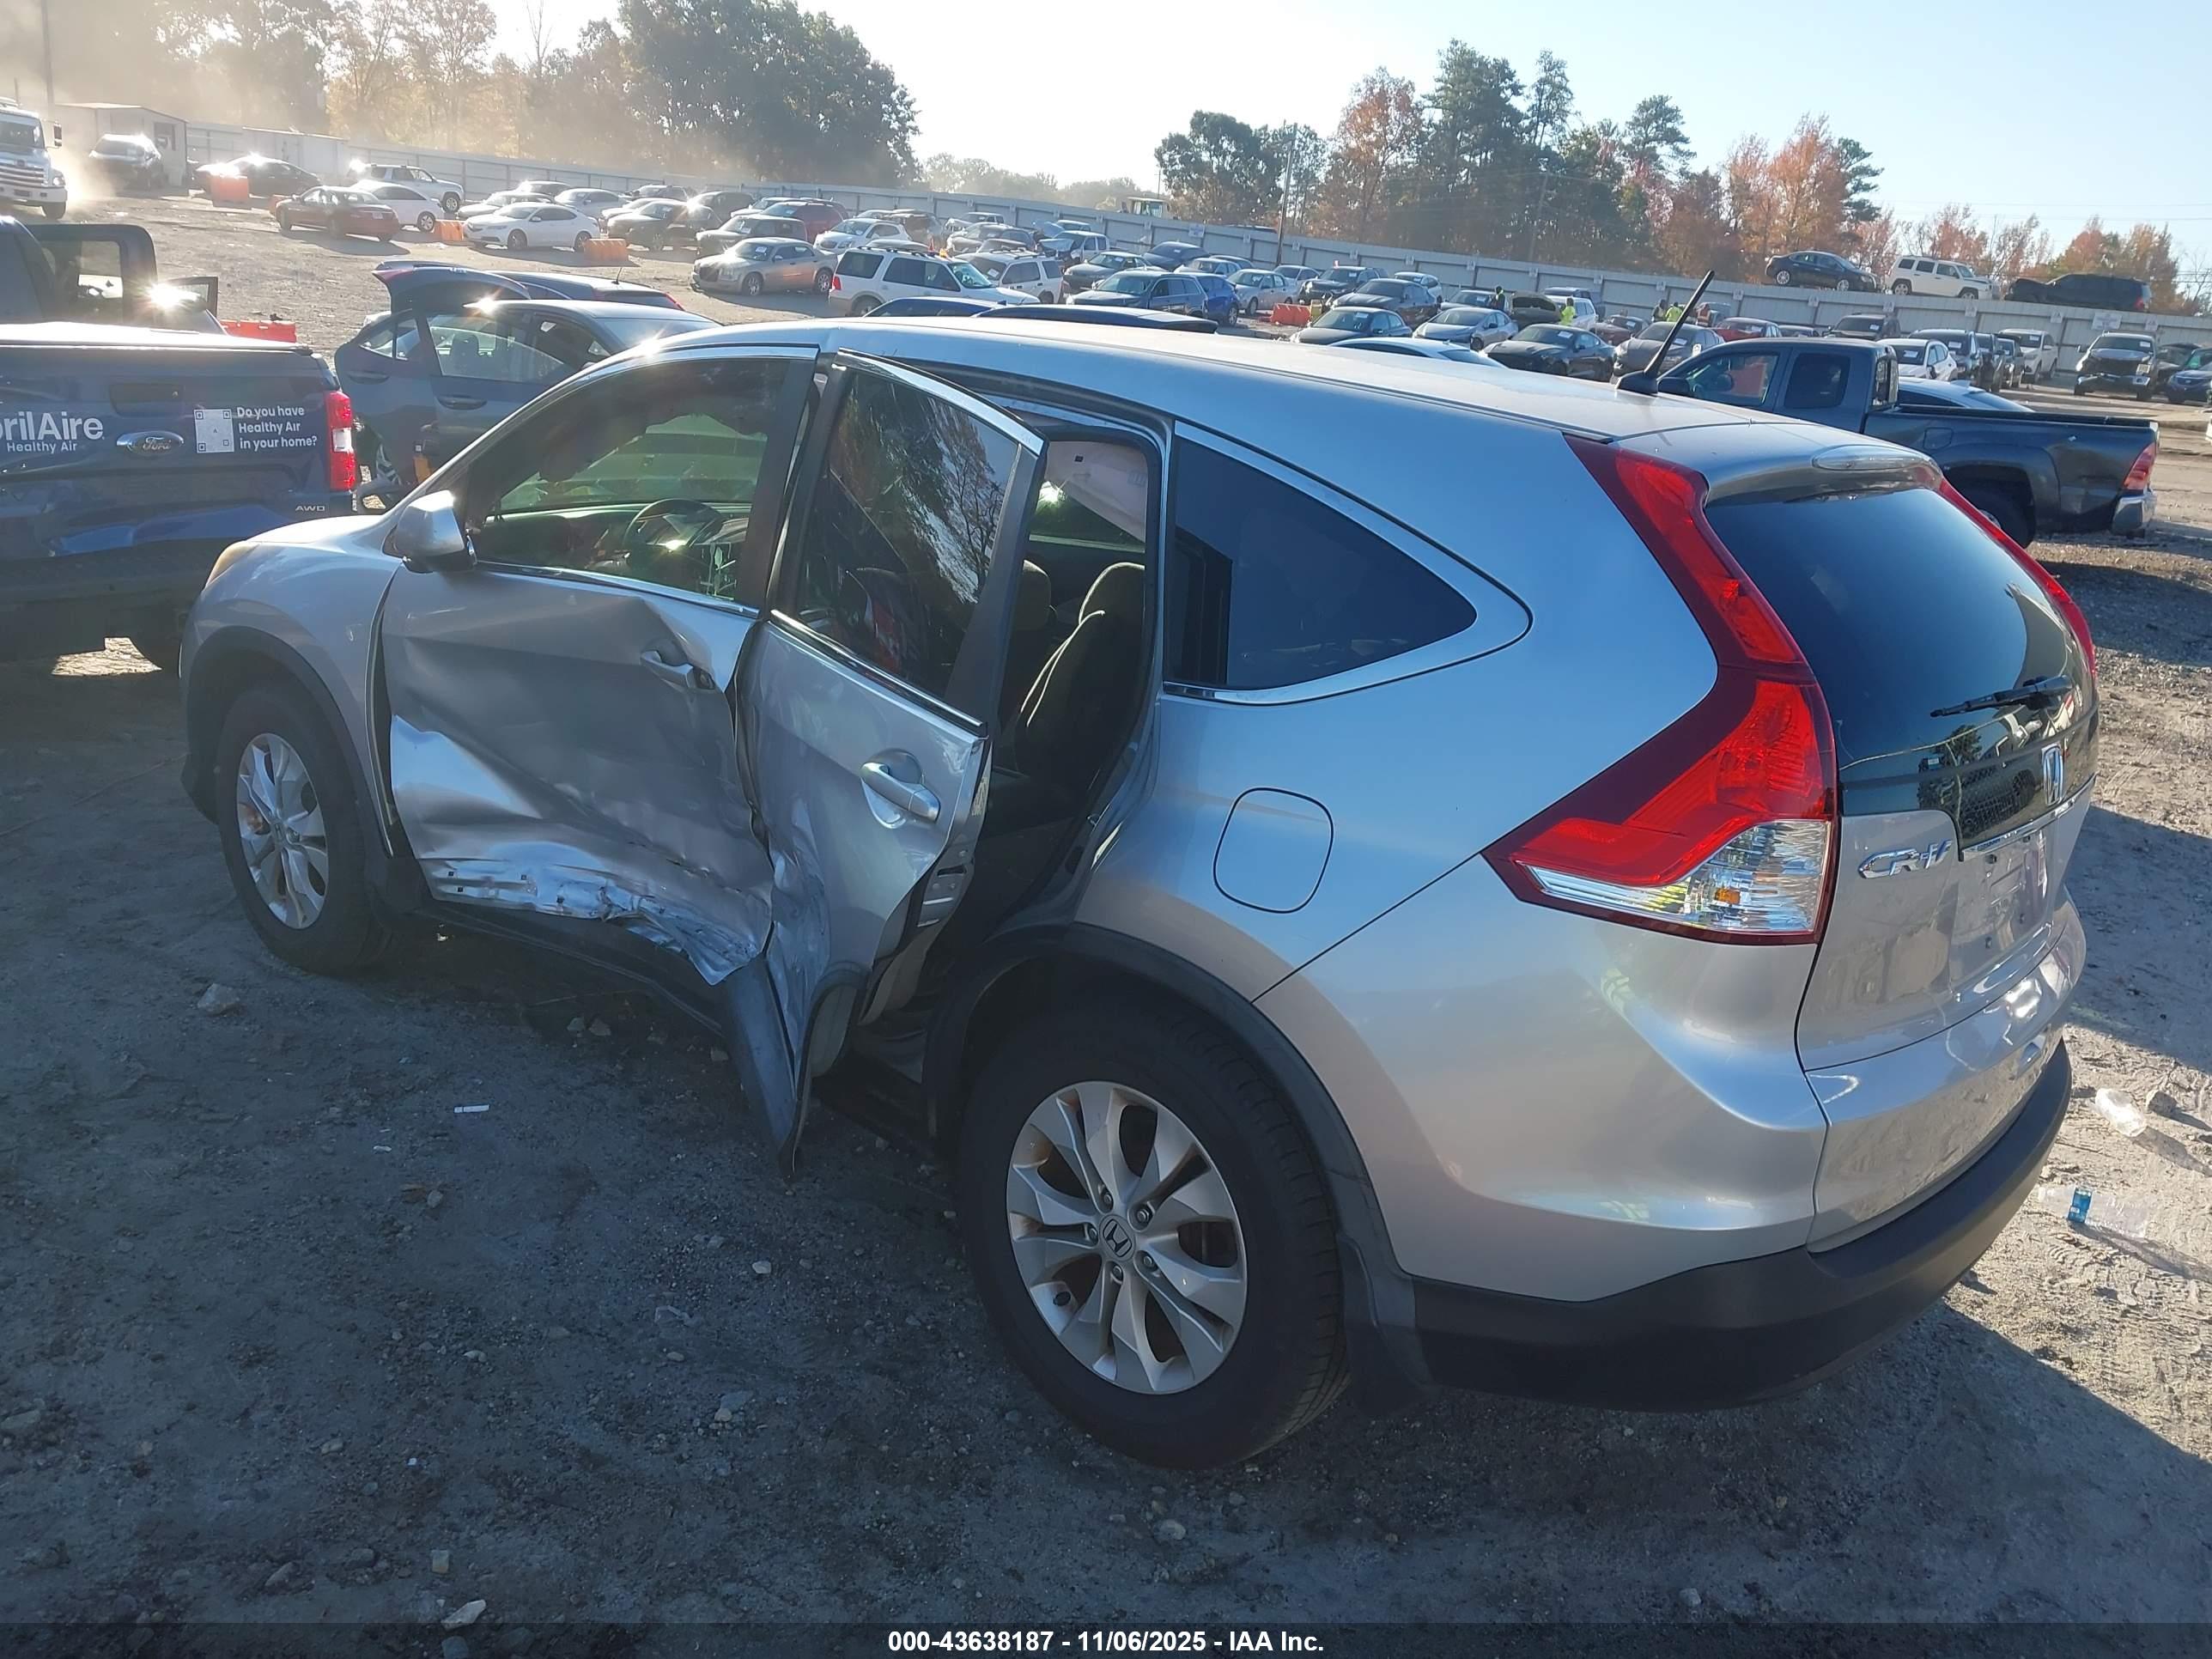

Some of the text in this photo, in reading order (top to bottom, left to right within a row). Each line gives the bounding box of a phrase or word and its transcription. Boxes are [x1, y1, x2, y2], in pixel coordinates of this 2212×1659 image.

[236, 404, 305, 421] Do you have
[0, 410, 103, 441] rilAire
[238, 421, 301, 435] Healthy Air
[6, 441, 78, 454] Healthy Air
[240, 434, 318, 452] in your home?
